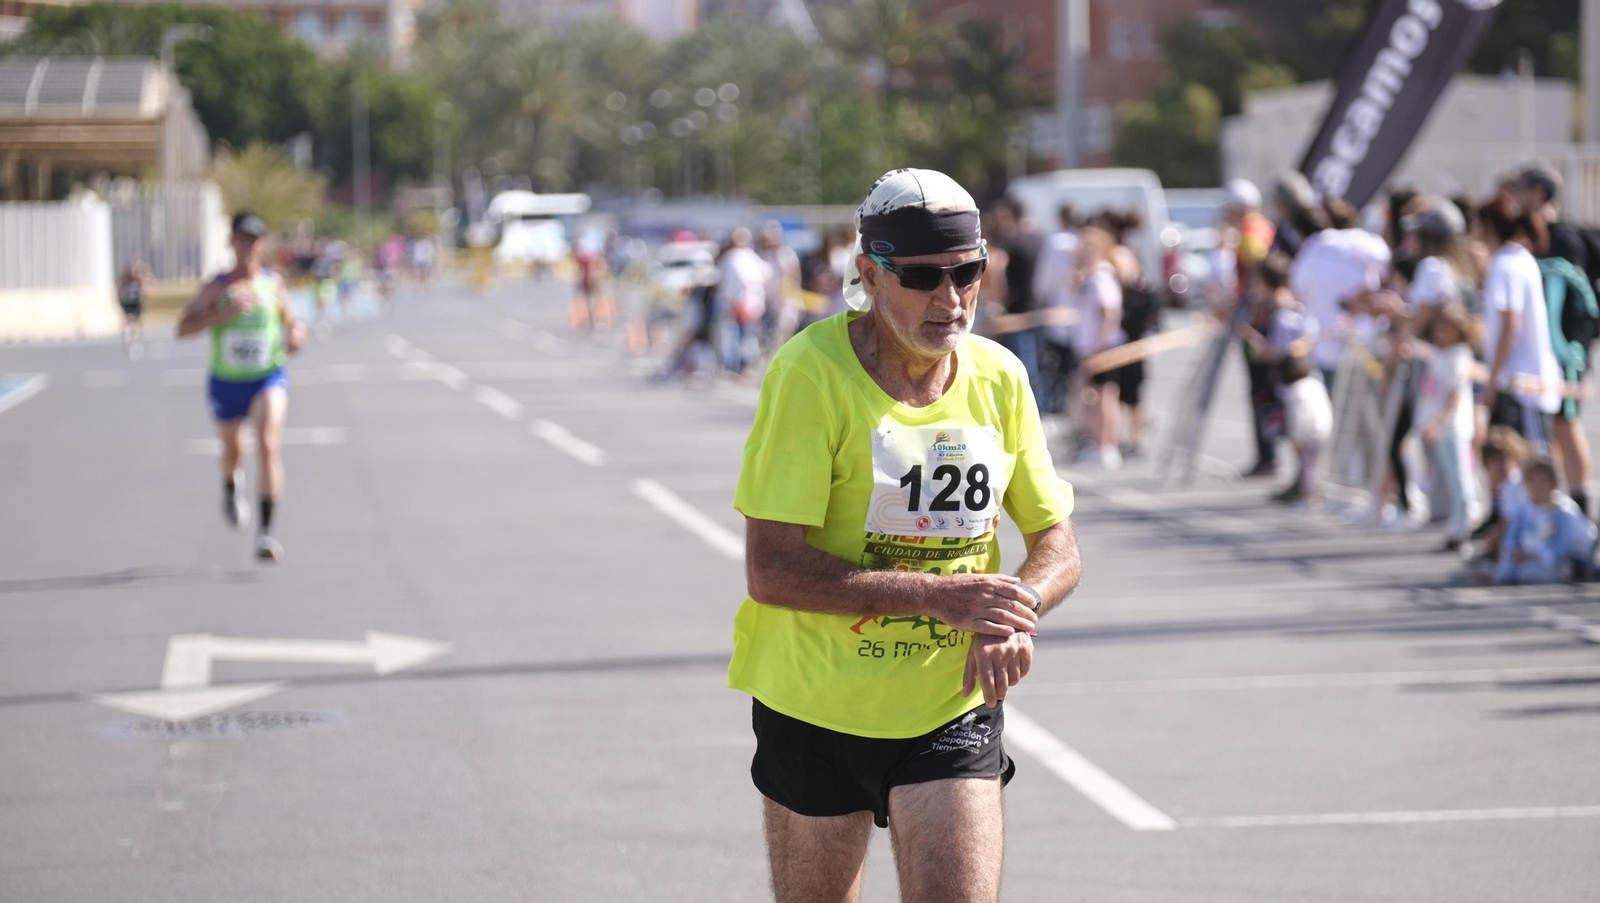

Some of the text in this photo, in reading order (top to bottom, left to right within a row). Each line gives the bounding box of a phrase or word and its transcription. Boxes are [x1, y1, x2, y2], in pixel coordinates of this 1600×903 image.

[900, 463, 991, 511] 128
[874, 545, 921, 559] CIUDAD
[925, 550, 941, 559] DE
[858, 639, 885, 658] 26
